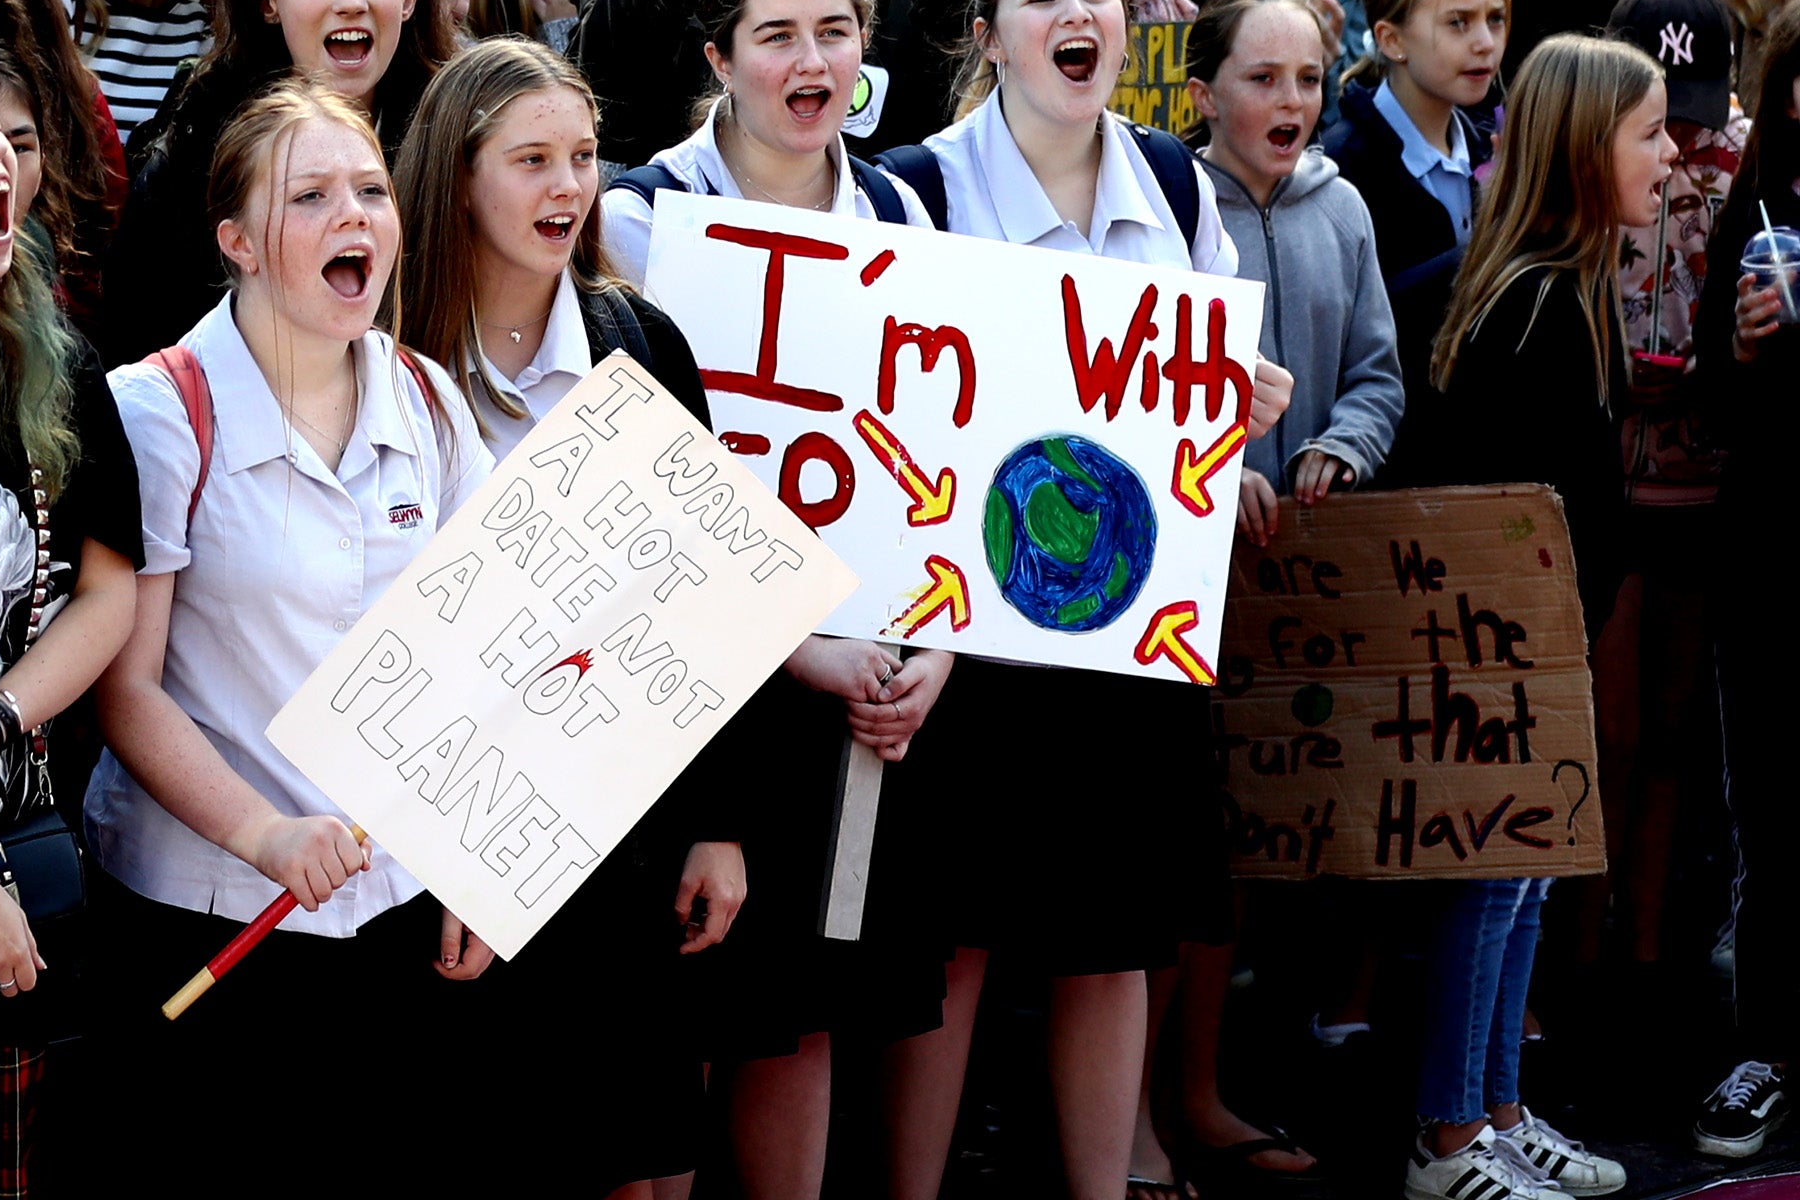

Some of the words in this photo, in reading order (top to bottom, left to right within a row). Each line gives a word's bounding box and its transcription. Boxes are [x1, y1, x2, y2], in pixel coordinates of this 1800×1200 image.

[699, 223, 977, 429] I'm
[1061, 273, 1255, 425] With
[529, 433, 593, 497] A
[584, 480, 707, 603] HOT
[576, 366, 654, 441] I
[653, 431, 804, 584] WANT
[416, 551, 484, 624] A
[479, 606, 620, 738] HOT
[482, 477, 617, 623] DATE
[601, 612, 725, 729] NOT
[1257, 554, 1342, 599] are
[1390, 540, 1447, 597] We
[1411, 593, 1534, 669] the
[331, 629, 601, 910] PLANET
[1372, 663, 1536, 764] that
